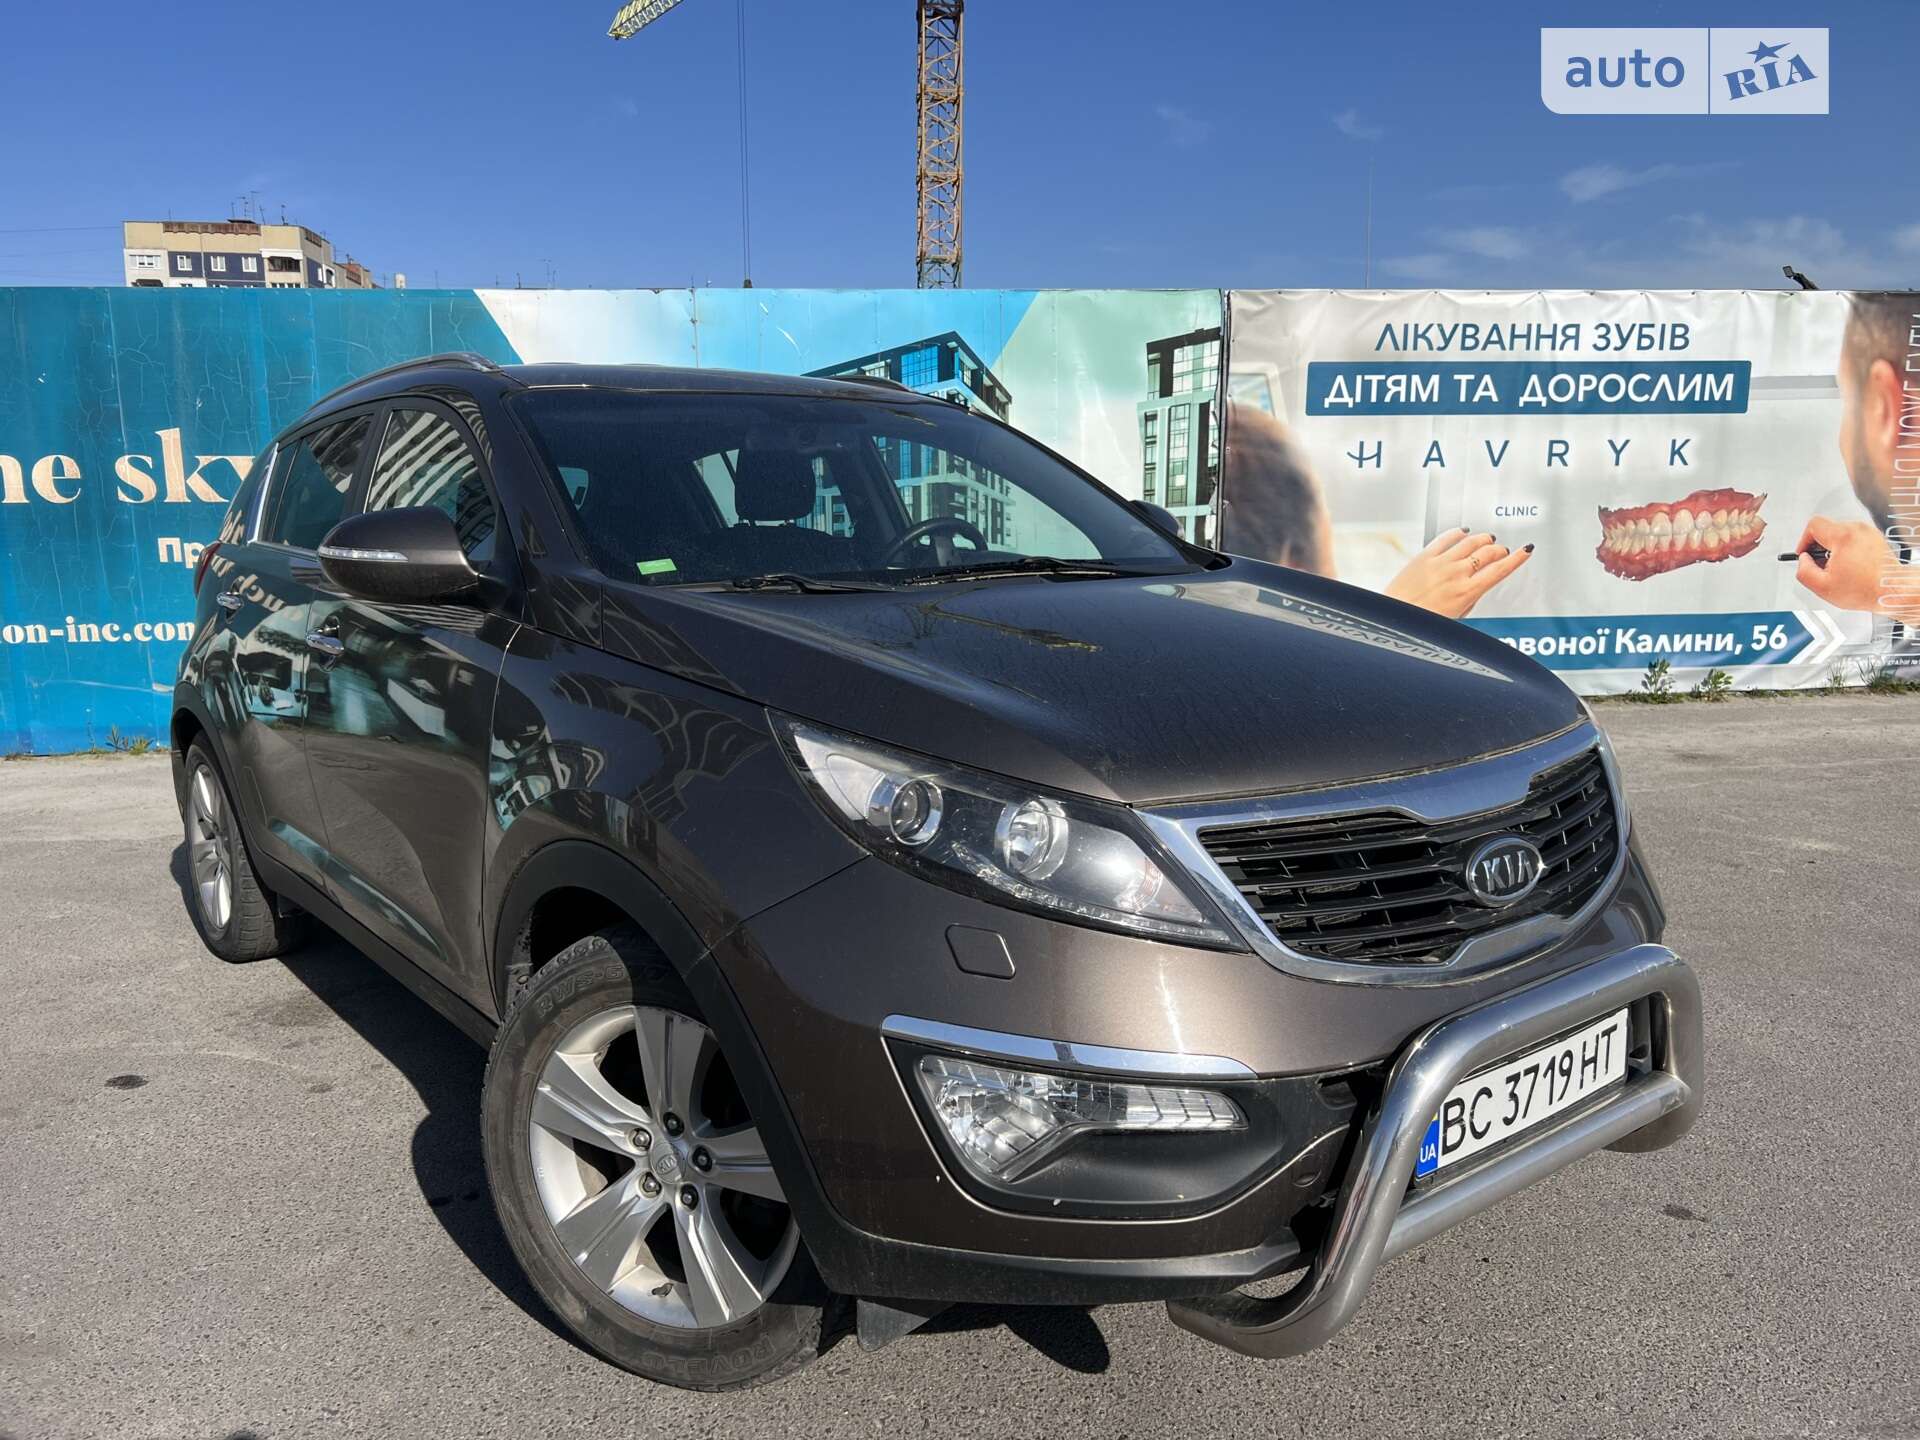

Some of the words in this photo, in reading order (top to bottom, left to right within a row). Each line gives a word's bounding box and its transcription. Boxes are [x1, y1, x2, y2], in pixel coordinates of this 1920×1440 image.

[1374, 322, 1581, 352] ЛІКУВАННЯ
[1591, 322, 1691, 352] ЗУБІВ
[1323, 373, 1441, 409] ДІТЯМ
[1453, 373, 1500, 402] ТА
[1517, 372, 1736, 409] ДОРОСЛИМ
[1346, 437, 1692, 469] HAVRYK
[1494, 504, 1539, 518] CLINIC
[1614, 627, 1743, 655] Калини,
[1751, 624, 1788, 651] 56
[1482, 849, 1535, 894] KIA
[1440, 1086, 1494, 1157] BC
[1503, 1048, 1574, 1128] 3719
[1579, 1023, 1618, 1092] HT
[1419, 1142, 1437, 1163] UA
